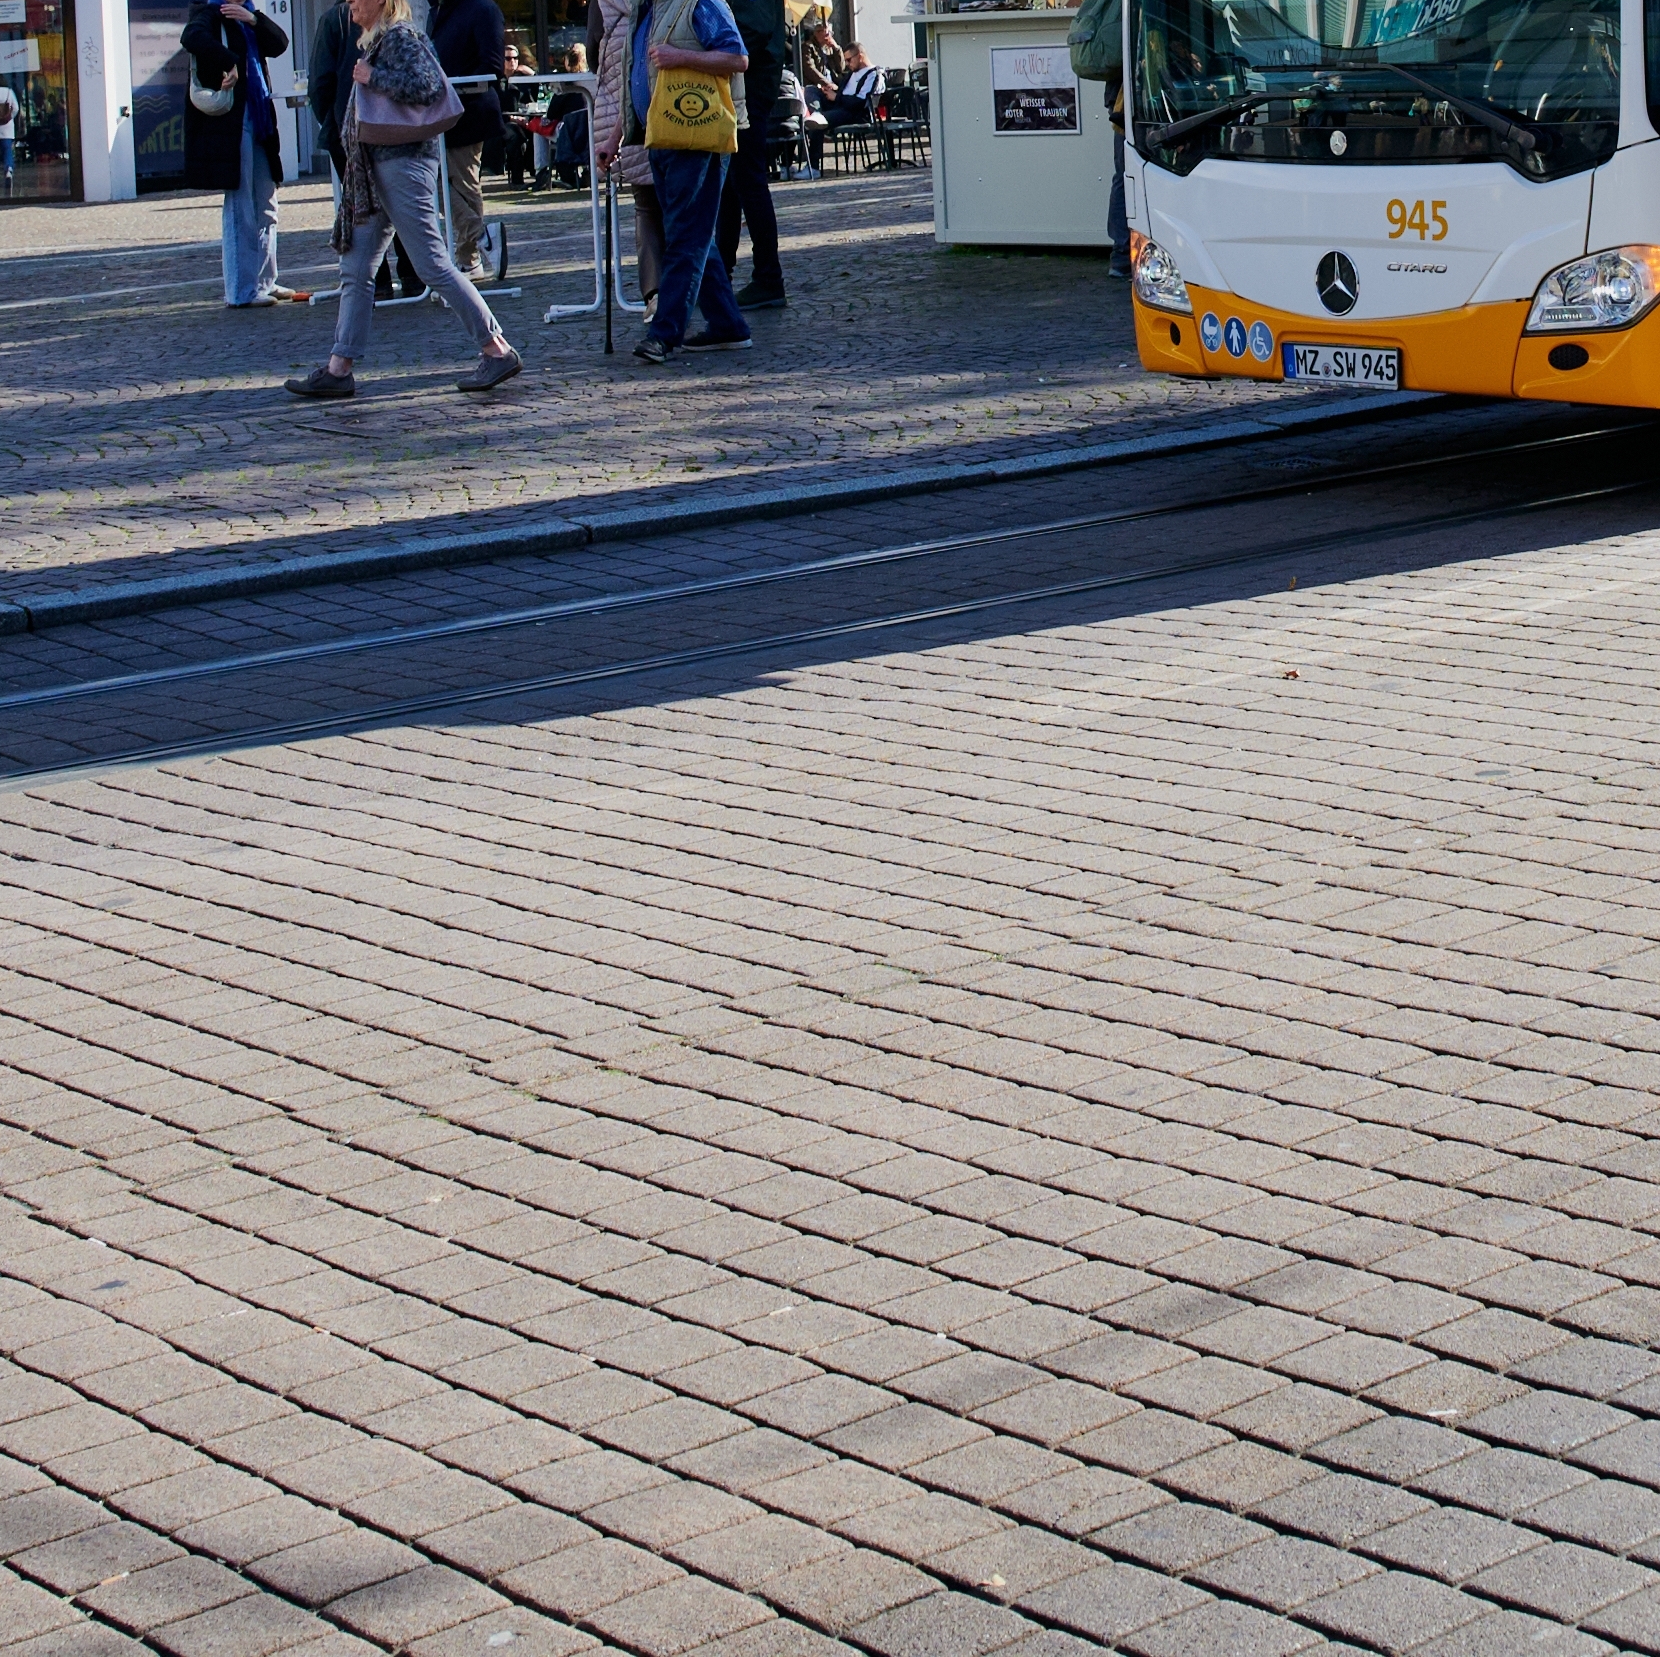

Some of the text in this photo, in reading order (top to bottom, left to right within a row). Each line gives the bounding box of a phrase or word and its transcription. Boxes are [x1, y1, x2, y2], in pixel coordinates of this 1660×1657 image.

[270, 0, 288, 14] 18
[1019, 97, 1046, 108] WEISSER
[662, 109, 722, 127] NEIN DANKE!
[1005, 107, 1068, 118] ROTER TRAUBEN
[1386, 198, 1449, 242] 945
[1386, 261, 1448, 274] CITARO
[1295, 348, 1397, 382] MZ SW 945
